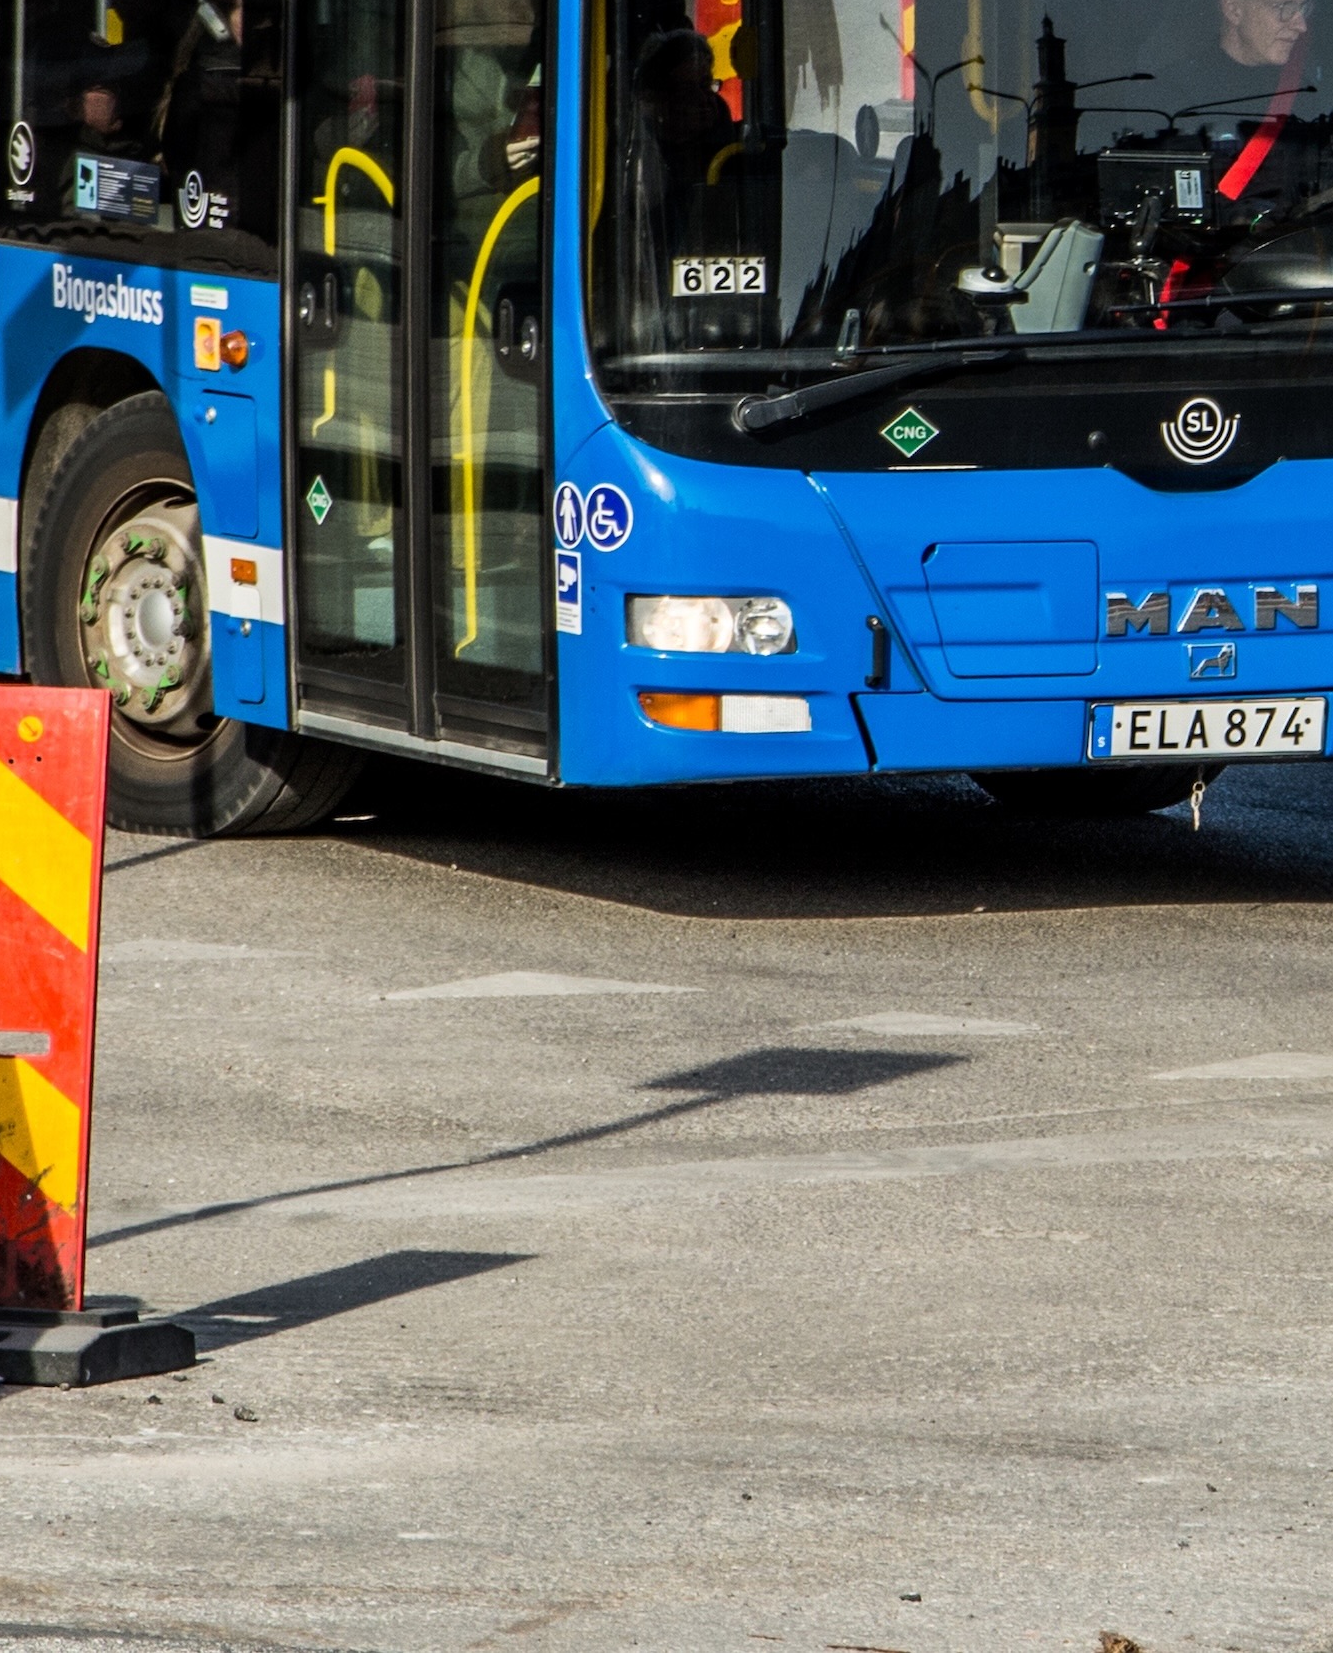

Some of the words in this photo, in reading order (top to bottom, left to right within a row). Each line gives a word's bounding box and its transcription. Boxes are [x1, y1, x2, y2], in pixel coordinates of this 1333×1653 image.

[52, 262, 164, 326] Biogasbuss
[683, 265, 763, 292] 622
[892, 425, 927, 440] CNG
[1186, 410, 1214, 434] SL
[1105, 584, 1318, 637] MAN
[1129, 709, 1209, 750] ELA
[1224, 706, 1304, 747] 874
